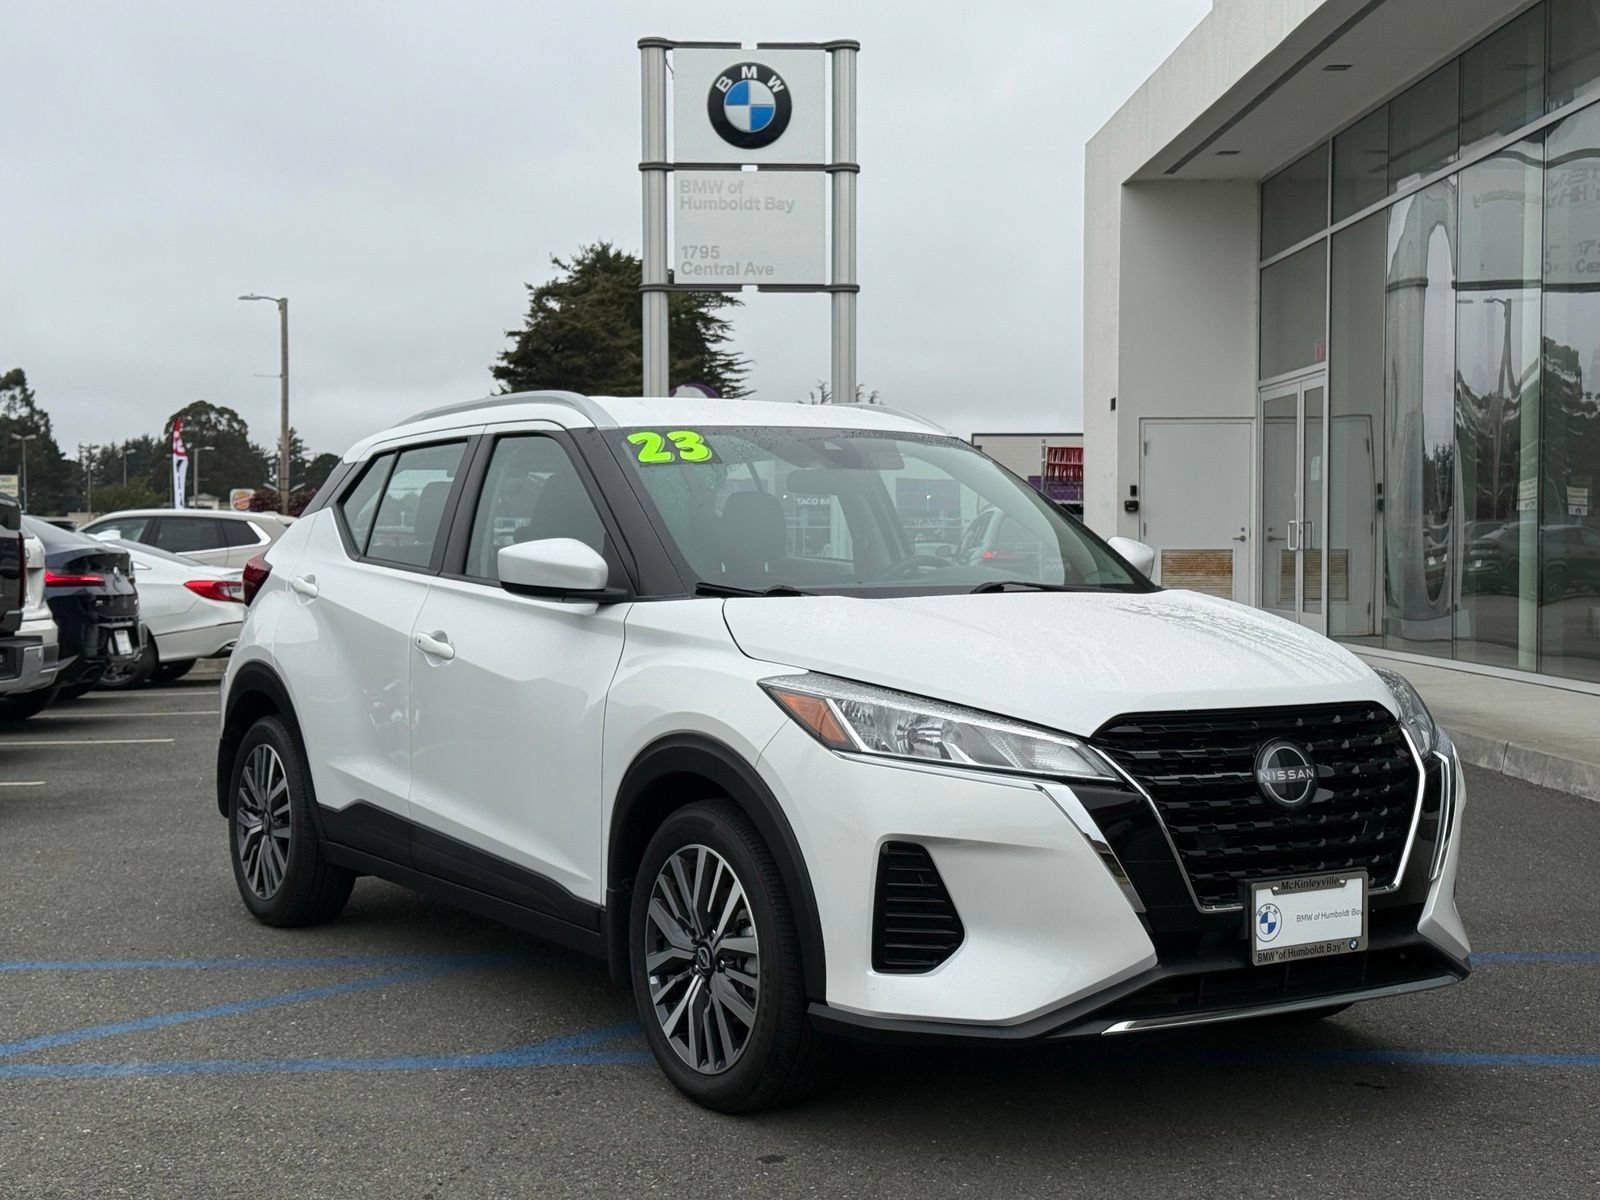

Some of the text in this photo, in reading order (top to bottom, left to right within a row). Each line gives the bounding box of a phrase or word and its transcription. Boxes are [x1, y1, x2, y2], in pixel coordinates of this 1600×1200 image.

[715, 65, 785, 93] BMW
[679, 179, 745, 194] BMW of
[679, 196, 795, 214] Humboldt Bay
[681, 245, 720, 259] 1795
[681, 261, 774, 276] Central Ave
[627, 430, 713, 463] 23
[797, 497, 819, 505] TACO
[1260, 768, 1314, 781] NISSAN
[1280, 877, 1339, 890] McKinleyville
[1257, 905, 1278, 917] BMW
[1296, 913, 1313, 923] BMW
[1322, 909, 1350, 919] Humboldt
[1278, 950, 1285, 960] of
[1288, 946, 1325, 958] Humboldt
